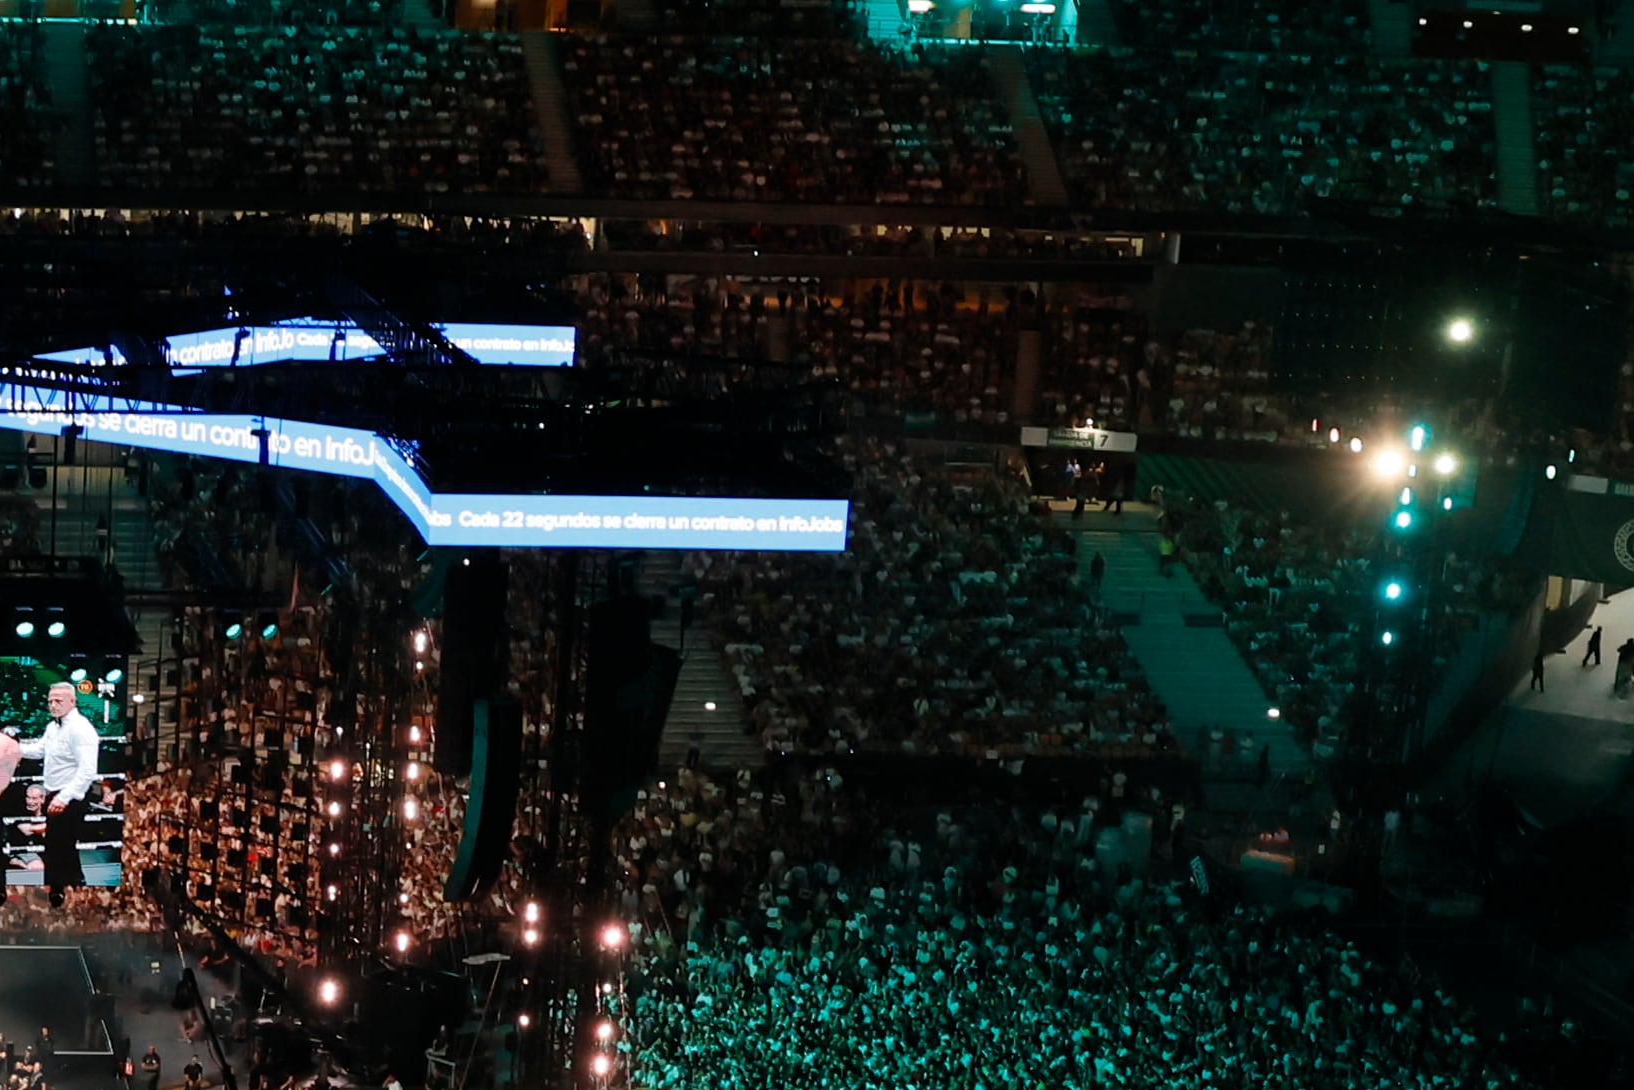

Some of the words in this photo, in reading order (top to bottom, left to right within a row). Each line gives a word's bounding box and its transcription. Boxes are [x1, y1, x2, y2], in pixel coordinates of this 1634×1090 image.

[98, 411, 121, 432] se
[125, 411, 178, 439] cierra
[181, 420, 206, 443] un
[294, 437, 321, 459] en
[1100, 435, 1109, 447] 7
[459, 510, 500, 527] Cada
[501, 511, 524, 528] 22
[525, 512, 601, 532] segundos
[602, 515, 622, 529] se
[623, 513, 666, 529] cierra
[669, 516, 690, 530] un
[691, 515, 755, 531] contrato
[756, 517, 778, 531] en
